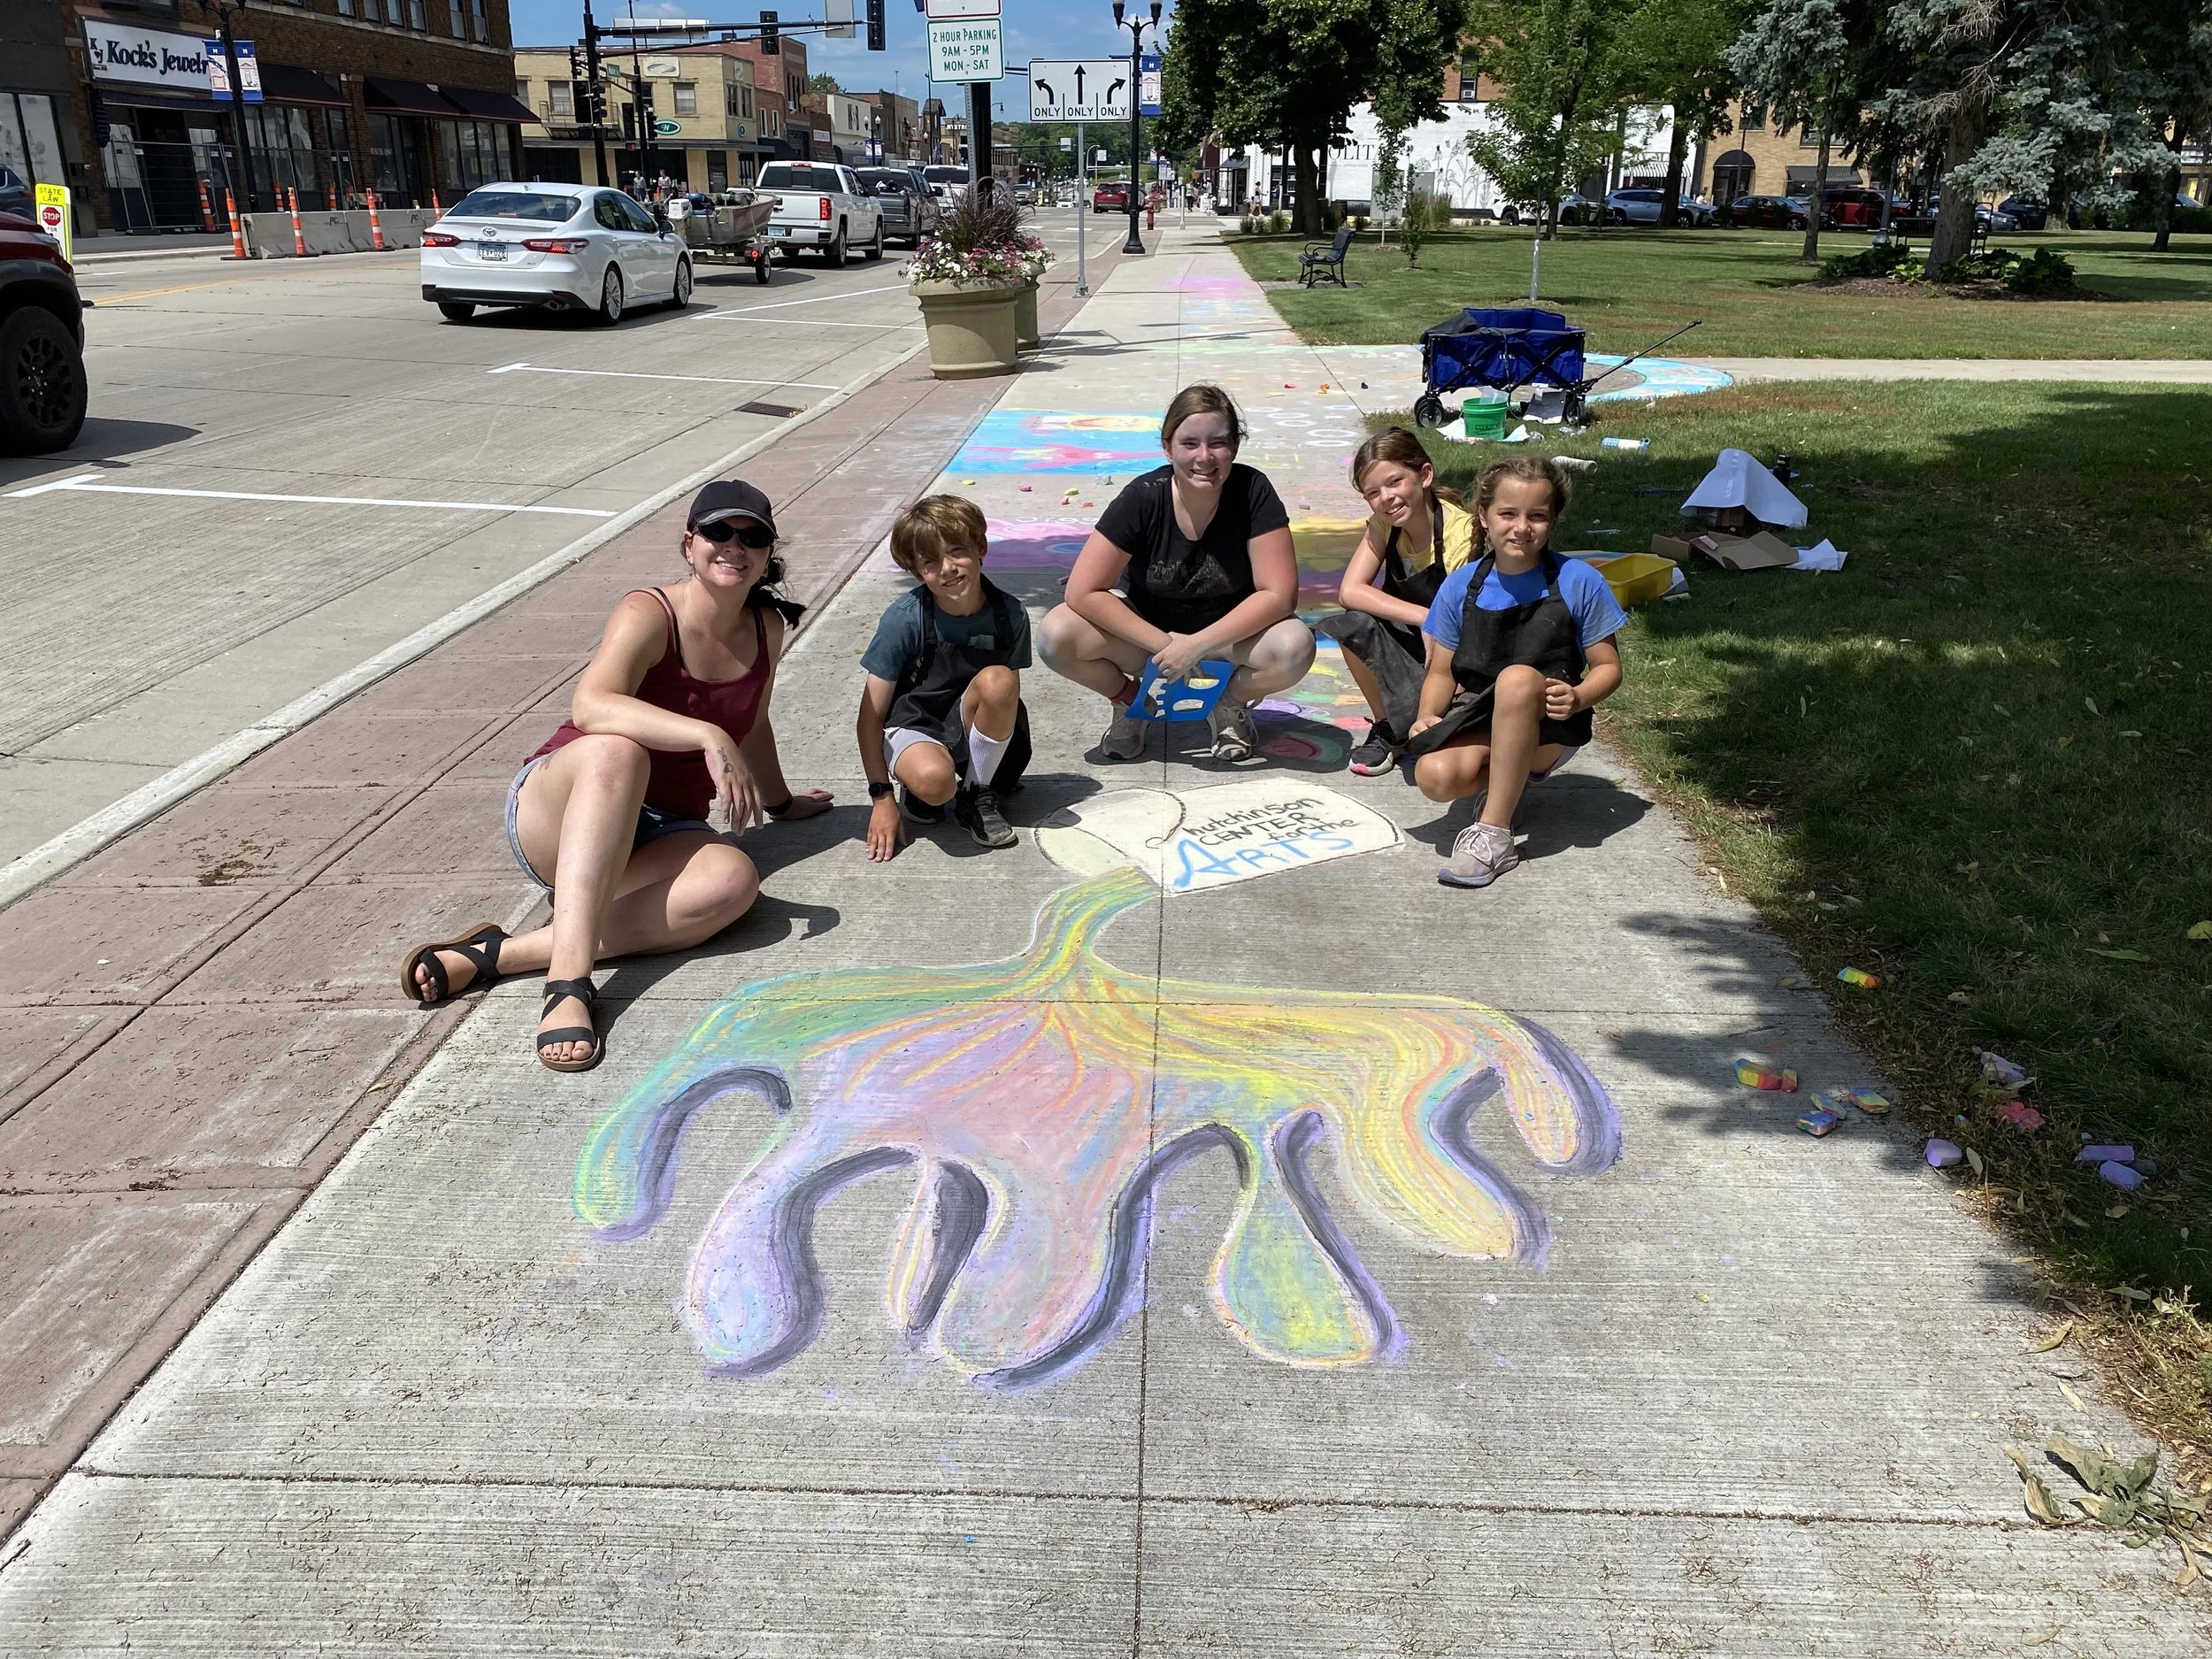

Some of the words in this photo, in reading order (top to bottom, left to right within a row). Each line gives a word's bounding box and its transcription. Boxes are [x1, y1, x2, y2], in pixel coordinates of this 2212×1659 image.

[933, 32, 938, 42] 2
[940, 31, 961, 42] HOUR
[964, 29, 996, 41] PARKING
[941, 46, 960, 57] 9AM
[970, 44, 989, 56] 5PM
[159, 48, 209, 75] Jewelr
[943, 61, 964, 72] MON
[973, 59, 989, 70] SAT
[1034, 107, 1061, 117] ONLY
[1067, 107, 1094, 117] ONLY
[1100, 107, 1127, 117] ONLY
[1328, 144, 1377, 160] OLIT
[1182, 797, 1325, 836] hutchinson
[1200, 811, 1321, 846] CENTER
[1174, 830, 1353, 888] ARTS
